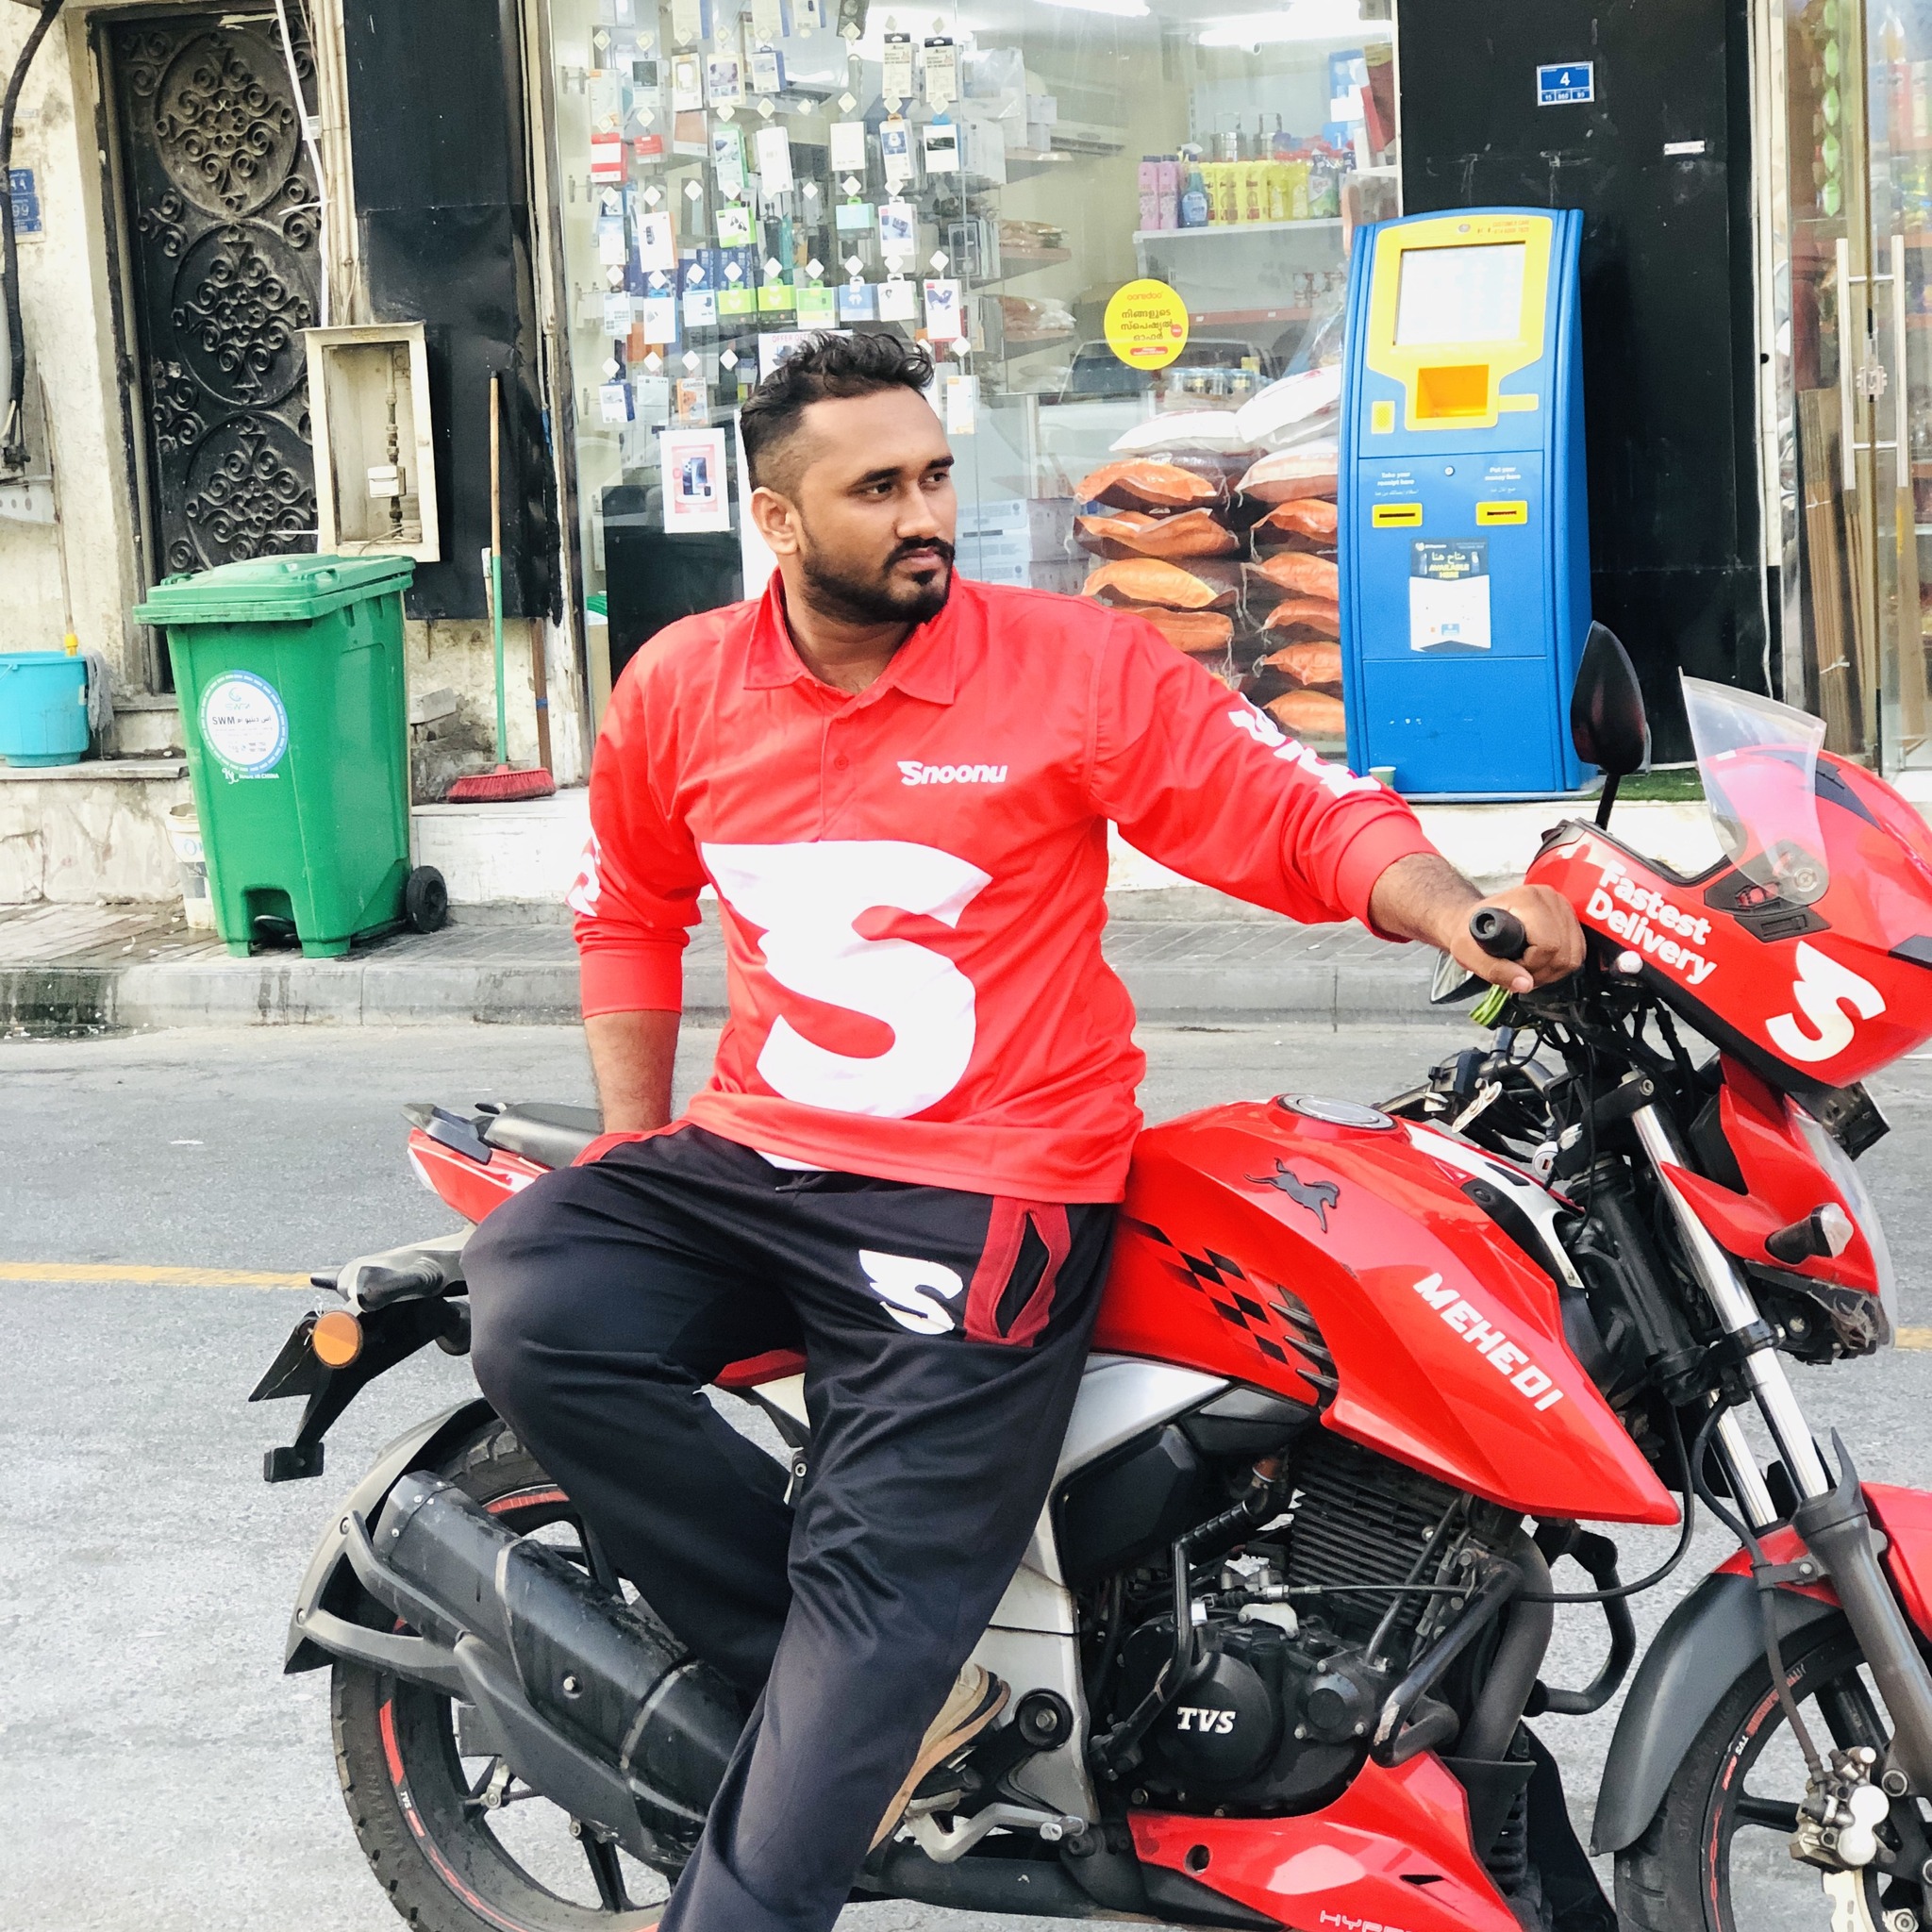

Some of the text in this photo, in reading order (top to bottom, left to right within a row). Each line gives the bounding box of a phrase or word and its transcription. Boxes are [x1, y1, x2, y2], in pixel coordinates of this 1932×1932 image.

[1559, 71, 1571, 87] 4
[1127, 292, 1162, 301] ooredoo
[212, 716, 236, 725] SWM
[897, 760, 1008, 786] Snoonu
[1599, 859, 1713, 945] Fastest
[1586, 888, 1718, 985] Delivery
[1413, 1273, 1564, 1411] MEHEDI
[1176, 1707, 1237, 1734] TVS
[1735, 1735, 1749, 1756] TVS
[400, 1790, 412, 1808] TVS
